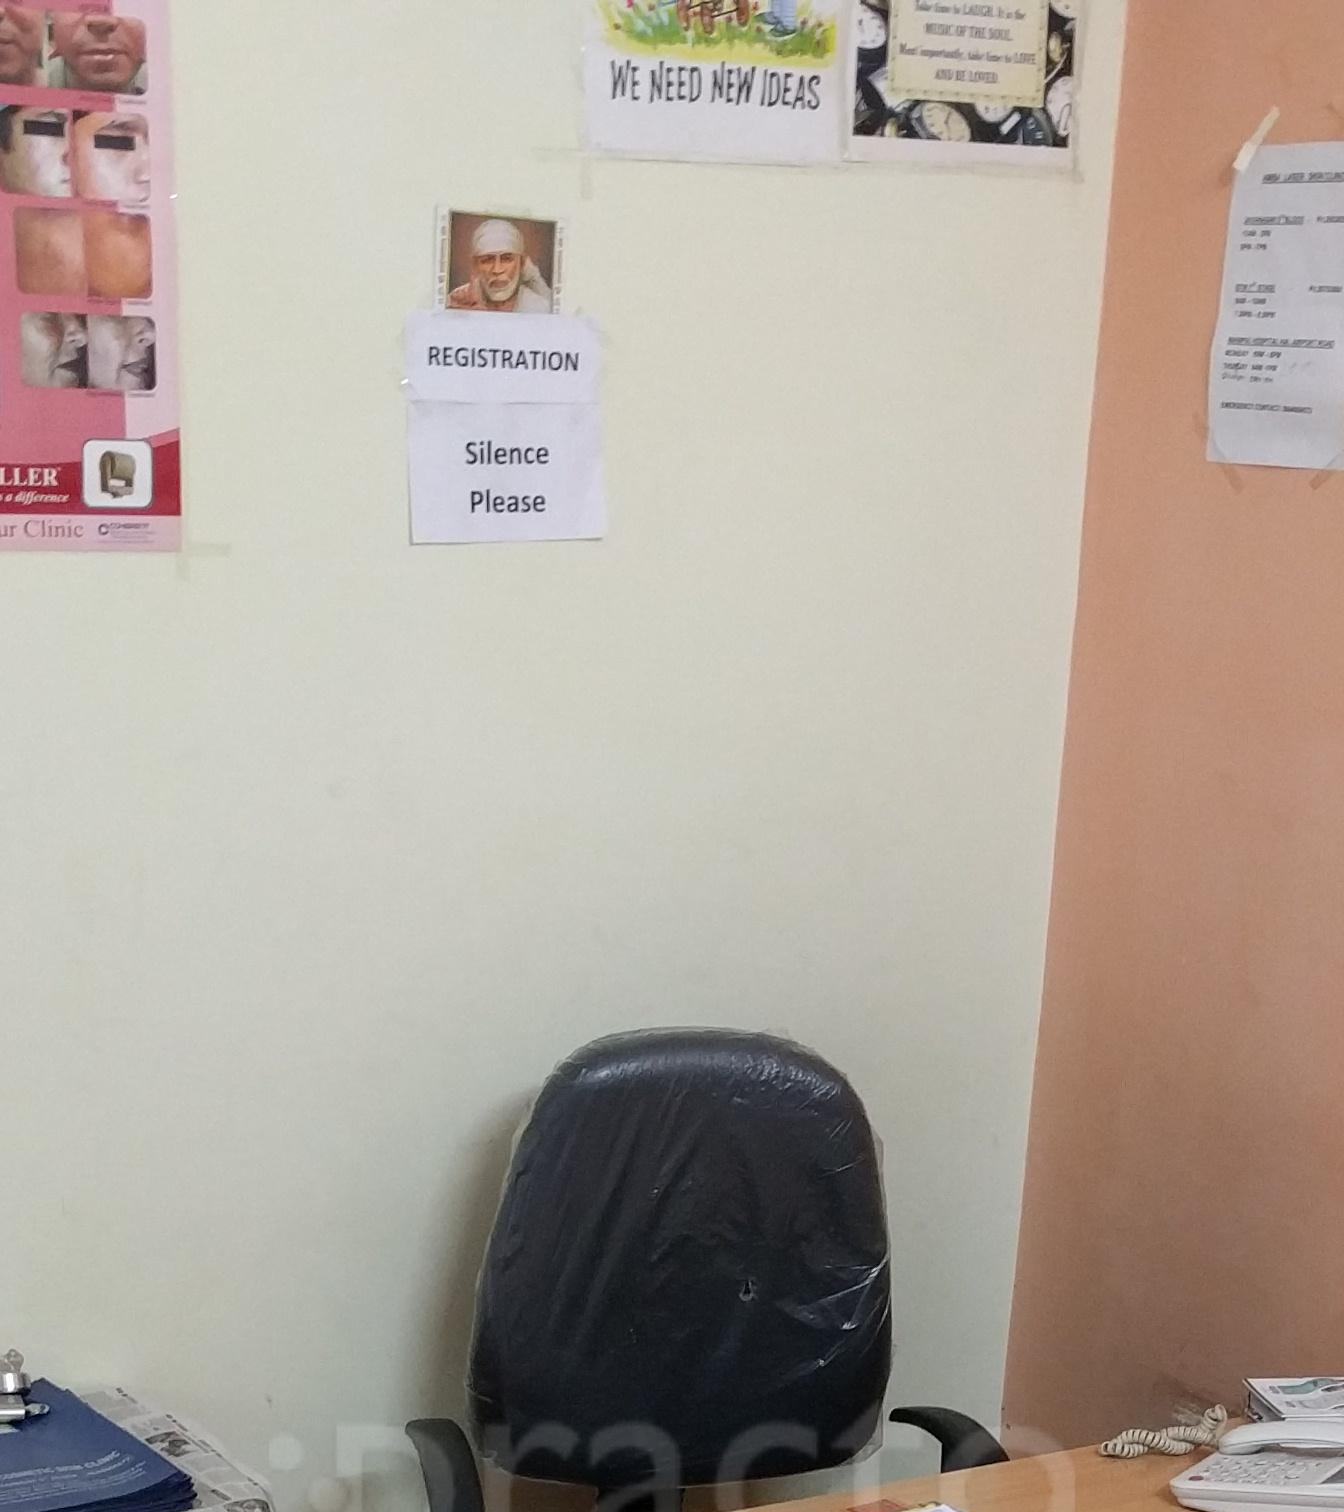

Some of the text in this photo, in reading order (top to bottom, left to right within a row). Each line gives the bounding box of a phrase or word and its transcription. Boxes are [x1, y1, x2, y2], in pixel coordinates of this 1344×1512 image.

[610, 59, 821, 110] WE NEED NEW IDEAS
[428, 345, 580, 372] REGISTRATION
[465, 440, 550, 466] Silence
[15, 491, 70, 505] difference
[470, 488, 547, 514] Please
[23, 519, 84, 538] Clinic
